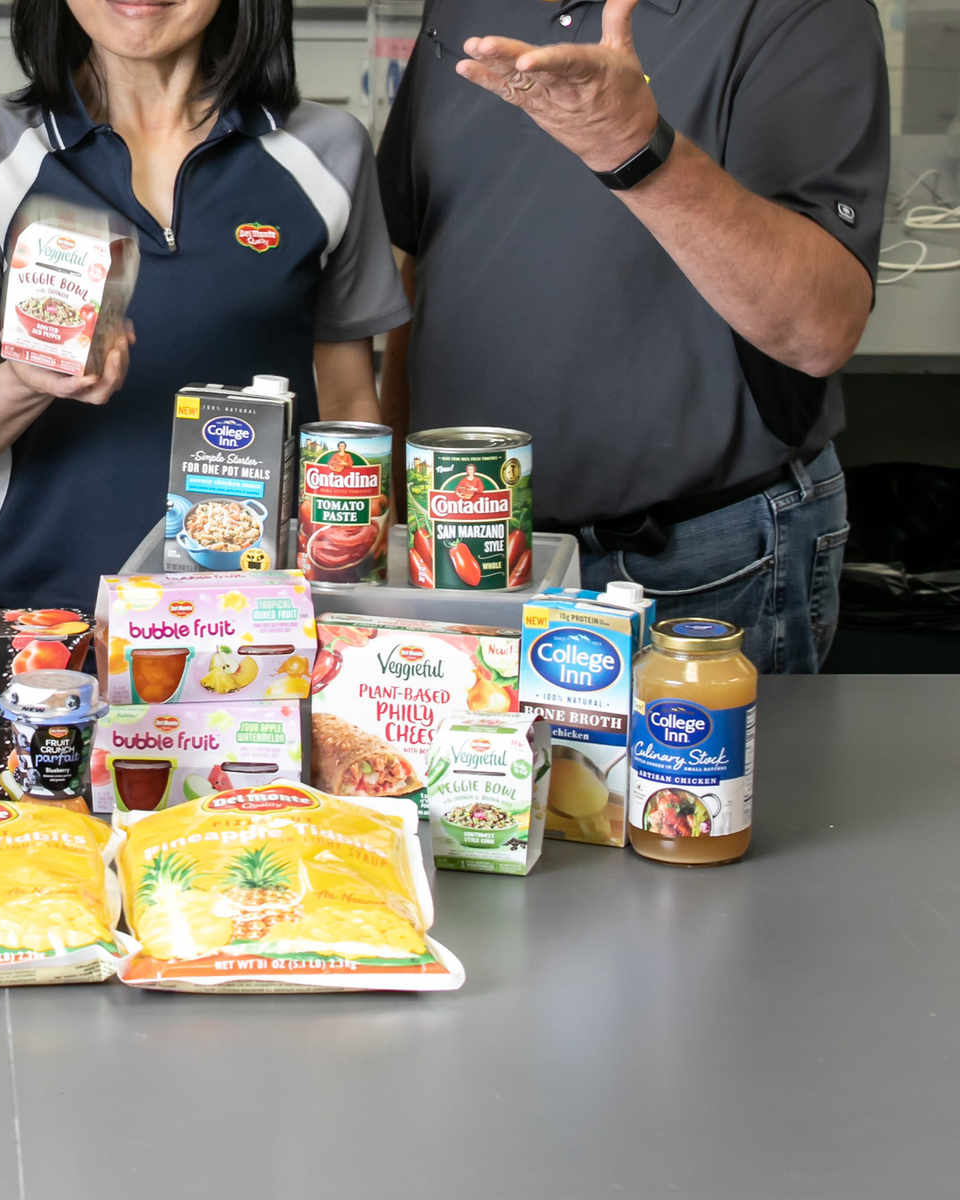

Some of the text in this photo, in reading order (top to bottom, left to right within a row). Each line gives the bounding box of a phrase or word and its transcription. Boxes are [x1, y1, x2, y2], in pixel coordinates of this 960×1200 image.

[247, 237, 268, 245] Quality
[252, 230, 276, 238] Monte
[38, 235, 88, 267] Veggieful
[18, 272, 89, 301] VEGGIE BOWL
[178, 406, 198, 415] NEW!
[207, 424, 250, 440] College
[219, 435, 238, 447] Inn
[182, 461, 271, 480] FOR ONE POT MEALS
[436, 464, 454, 473] New!
[306, 467, 378, 489] Contadina
[317, 499, 365, 511] TOMATO
[431, 494, 509, 516] Contadina
[323, 511, 357, 522] PASTE
[437, 524, 504, 539] SAN MARZANO
[484, 540, 504, 553] STYLE
[483, 562, 502, 570] WHOLE
[526, 616, 547, 626] NEW!
[560, 613, 598, 624] 10g PROTEIN
[129, 622, 190, 639] bubble
[194, 619, 235, 637] fruit
[488, 644, 512, 655] New!
[377, 644, 444, 680] Veggieful
[538, 643, 615, 672] College
[560, 664, 592, 686] Inn
[359, 683, 450, 704] PLANT-BASED
[544, 693, 602, 707] 100% NATURAL
[376, 701, 434, 727] PHILLY
[524, 706, 622, 729] BONE BROTH
[651, 712, 705, 733] College
[113, 731, 220, 751] bubble fruit
[552, 729, 589, 740] chicken
[665, 728, 688, 742] Inn
[40, 746, 75, 754] CRUNCH
[451, 737, 507, 769] Veggieful
[634, 741, 729, 770] Culinary Stock
[35, 751, 80, 767] parfait
[639, 770, 671, 782] ARTISAN
[212, 793, 310, 807] Del Monte
[241, 801, 282, 809] Quality
[215, 958, 357, 970] NET WT 81 OZ (5.1 LB) 2.3kg
